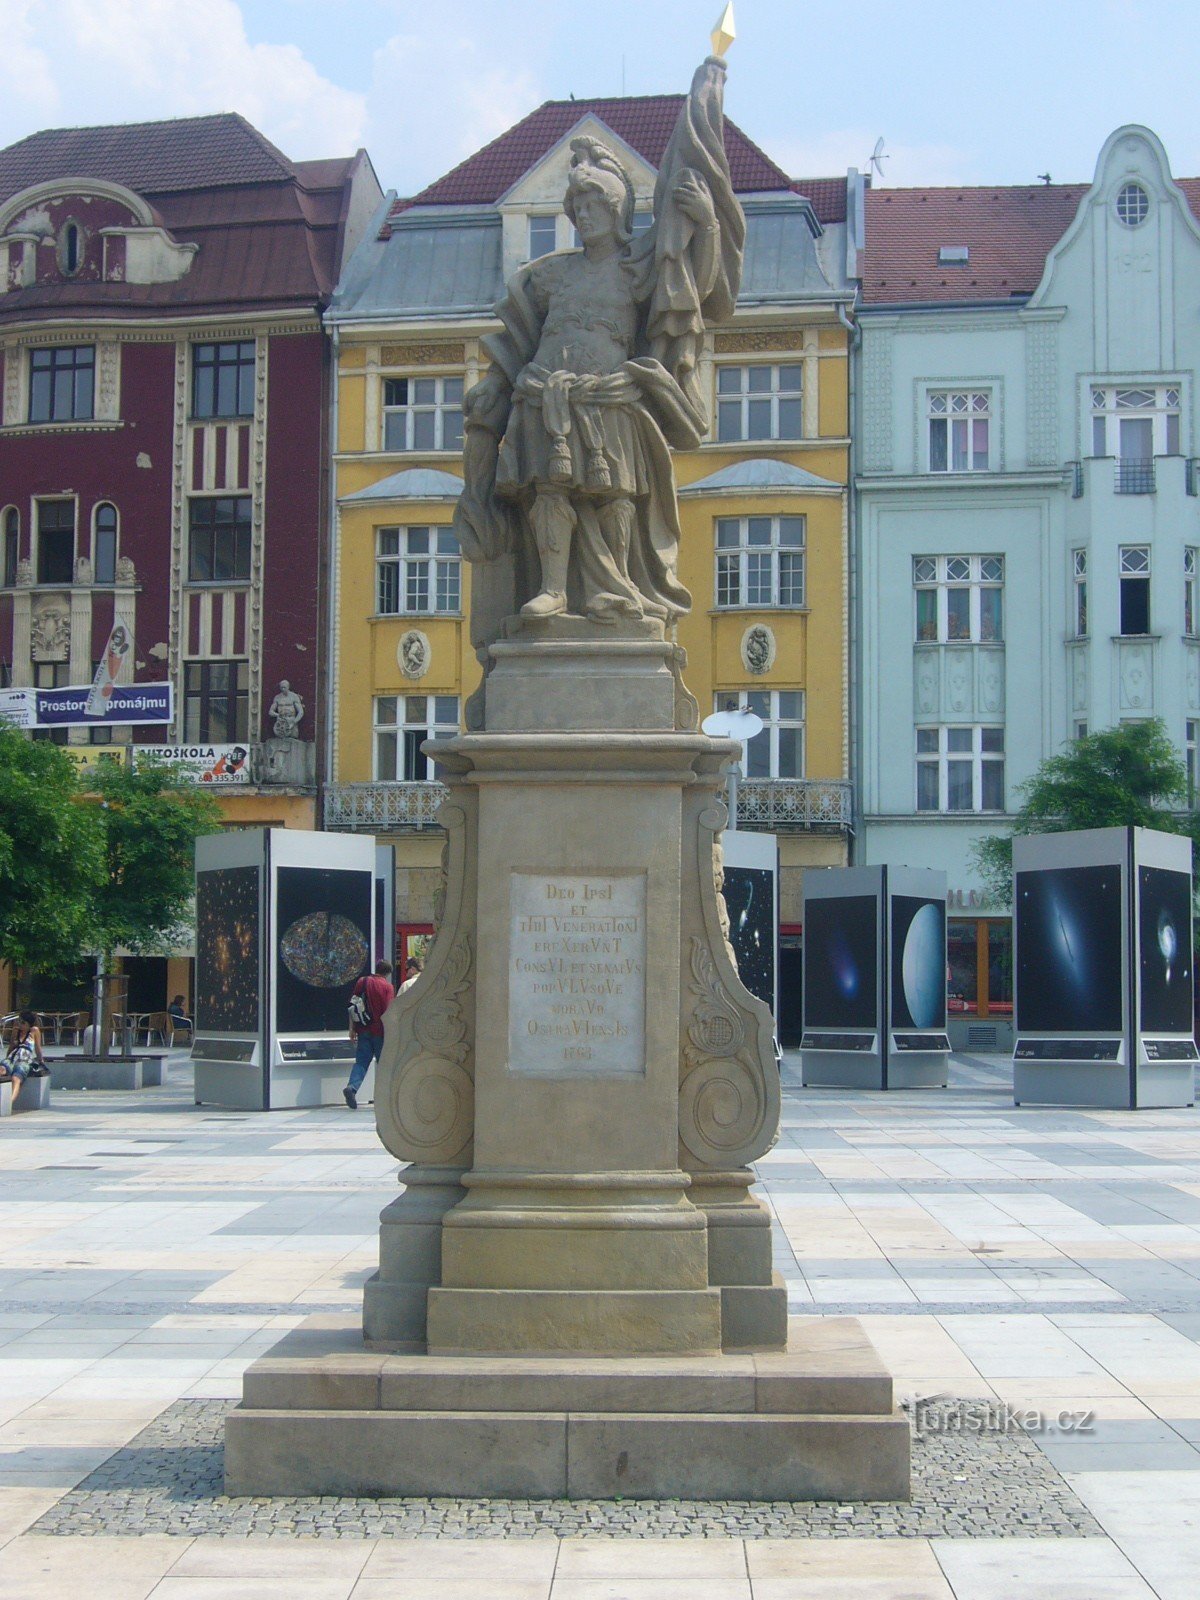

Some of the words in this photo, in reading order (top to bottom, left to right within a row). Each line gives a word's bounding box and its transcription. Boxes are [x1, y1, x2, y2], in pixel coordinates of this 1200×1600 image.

[105, 696, 167, 713] pronájmu
[140, 746, 215, 759] AUTOŠKOLA
[215, 774, 229, 783] 335
[230, 774, 244, 782] 391
[571, 905, 587, 916] ET
[571, 963, 587, 973] ET
